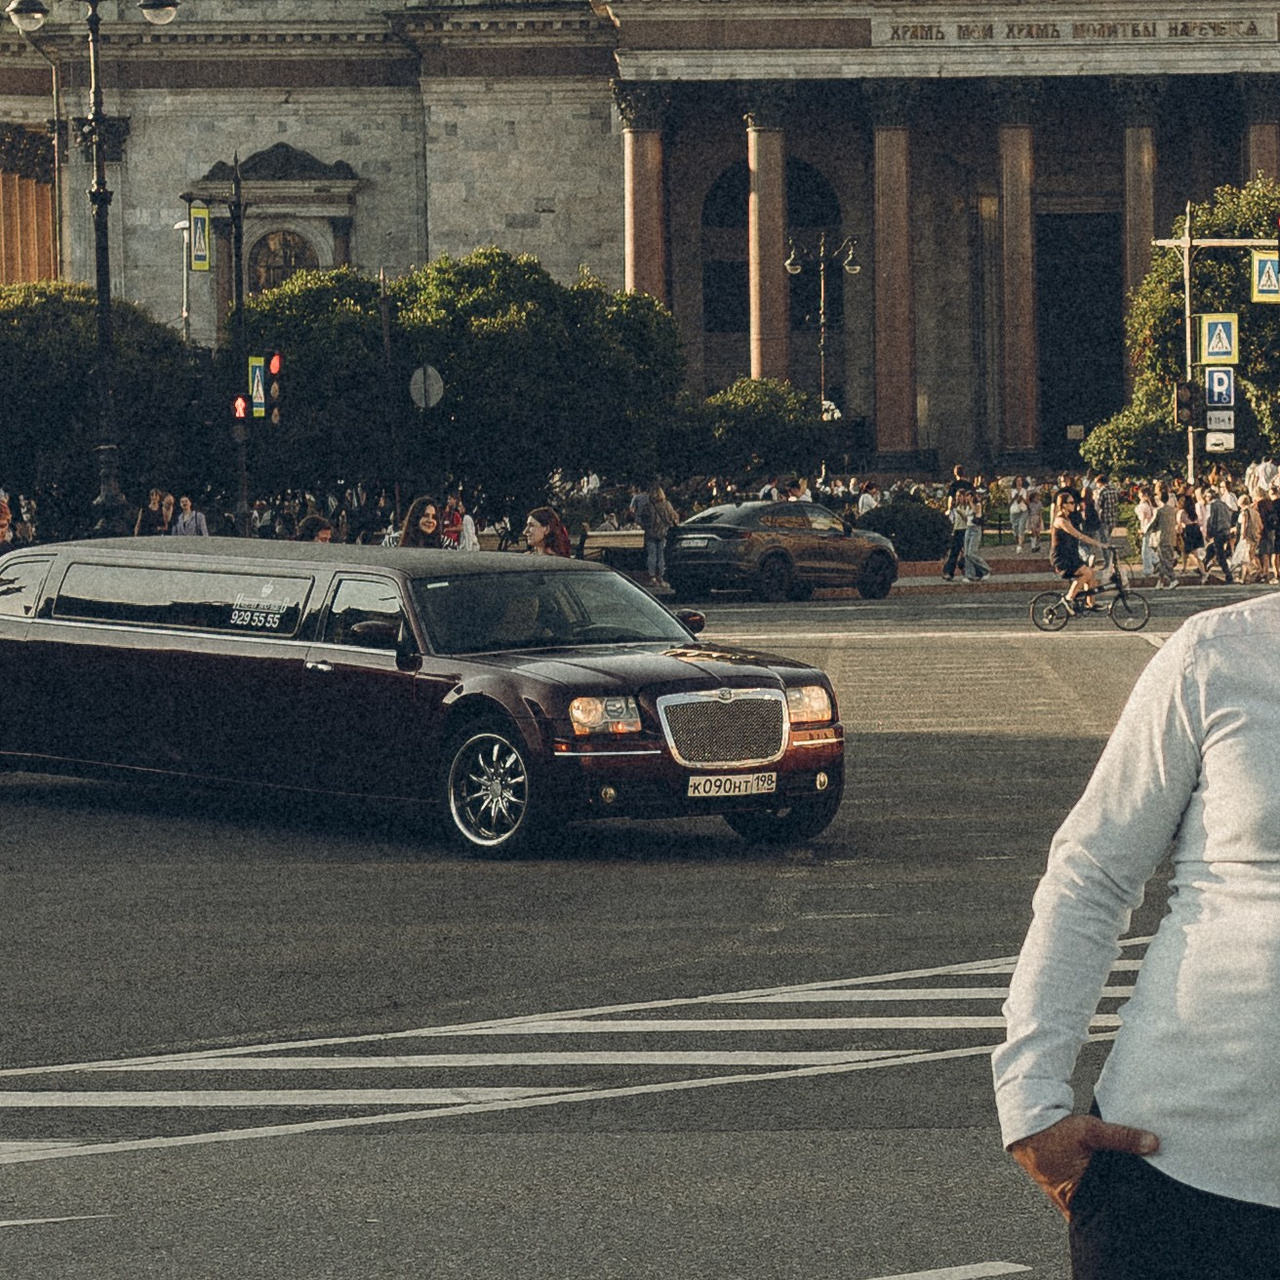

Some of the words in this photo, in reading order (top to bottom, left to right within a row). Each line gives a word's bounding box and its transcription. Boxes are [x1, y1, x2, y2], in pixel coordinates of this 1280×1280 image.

[1213, 372, 1229, 402] P
[230, 610, 251, 625] 929
[250, 612, 266, 627] 55
[265, 614, 280, 628] 55
[692, 778, 751, 795] К090НТ
[754, 774, 774, 787] 198
